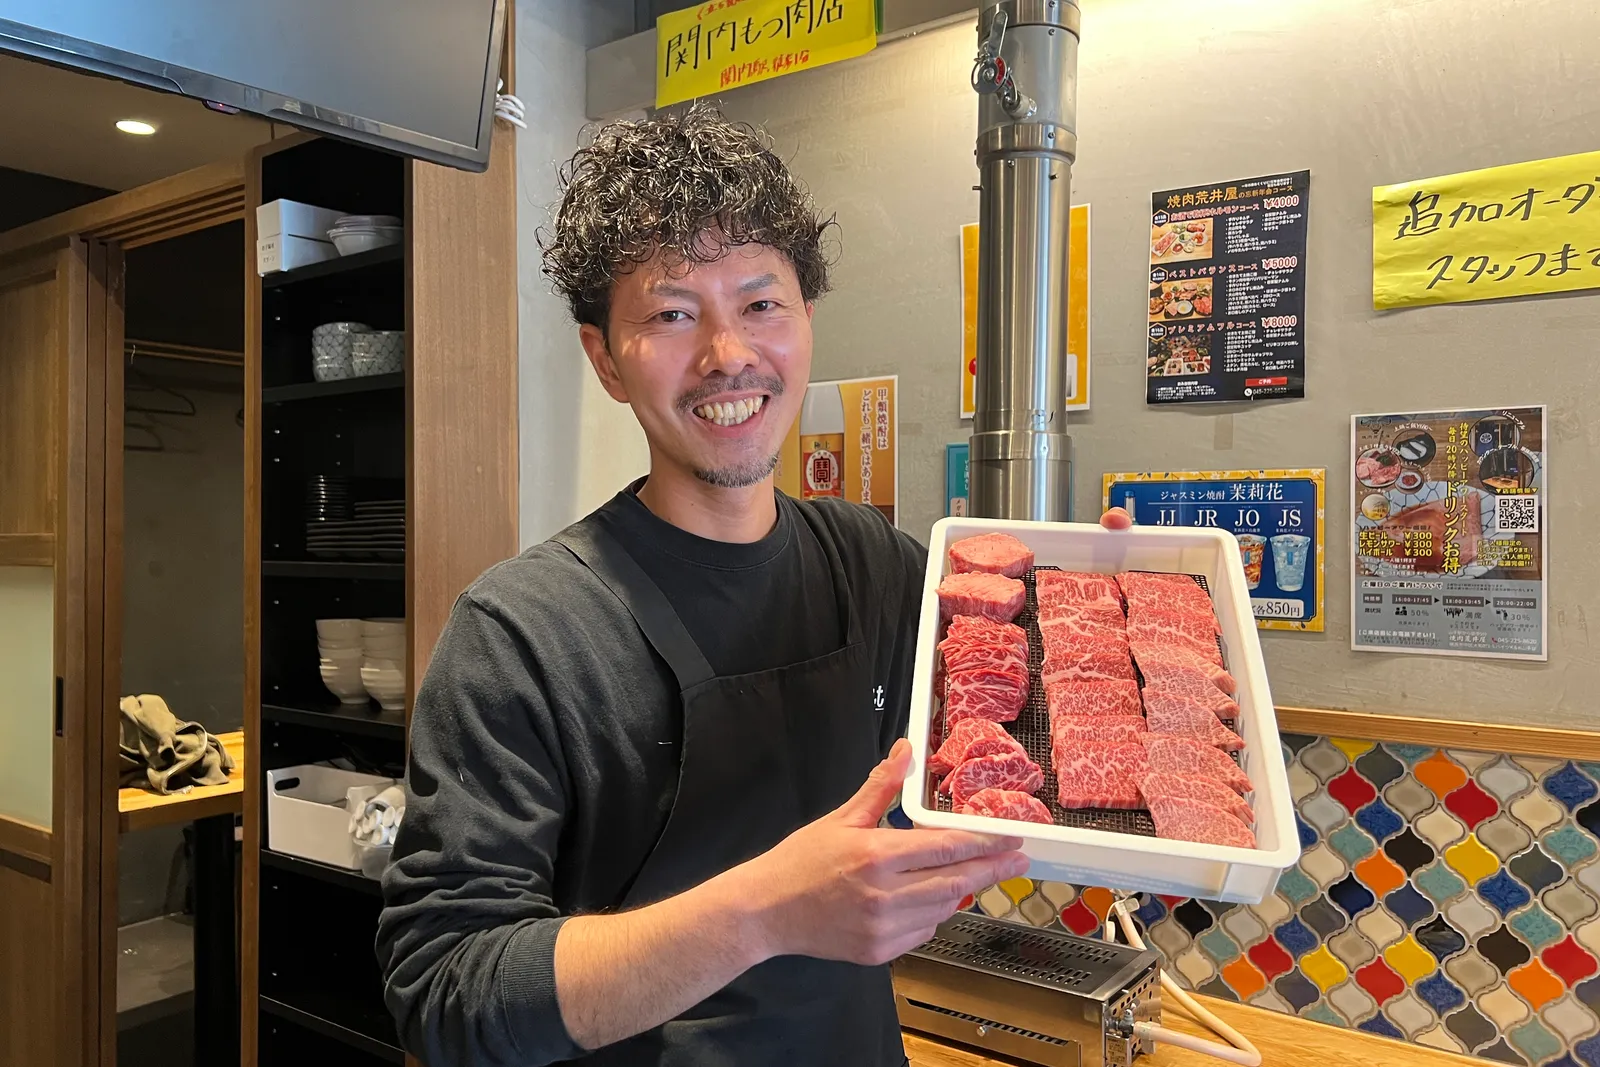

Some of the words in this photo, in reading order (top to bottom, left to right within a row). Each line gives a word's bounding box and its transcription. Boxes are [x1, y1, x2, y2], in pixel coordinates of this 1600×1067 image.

[1264, 195, 1299, 208] ¥4000
[1262, 256, 1297, 270] ¥5000
[1262, 315, 1297, 328] ¥8000
[862, 390, 872, 505] どれも一緒ではありま
[1160, 491, 1225, 500] ジャスミン焼酎
[1230, 483, 1283, 501] 茉莉花
[1157, 509, 1176, 526] JJ
[1194, 509, 1218, 527] JR
[1234, 510, 1260, 526] JO
[1278, 509, 1301, 527] JS
[1359, 531, 1388, 540] 生ビール
[1358, 548, 1393, 557] ハイボール
